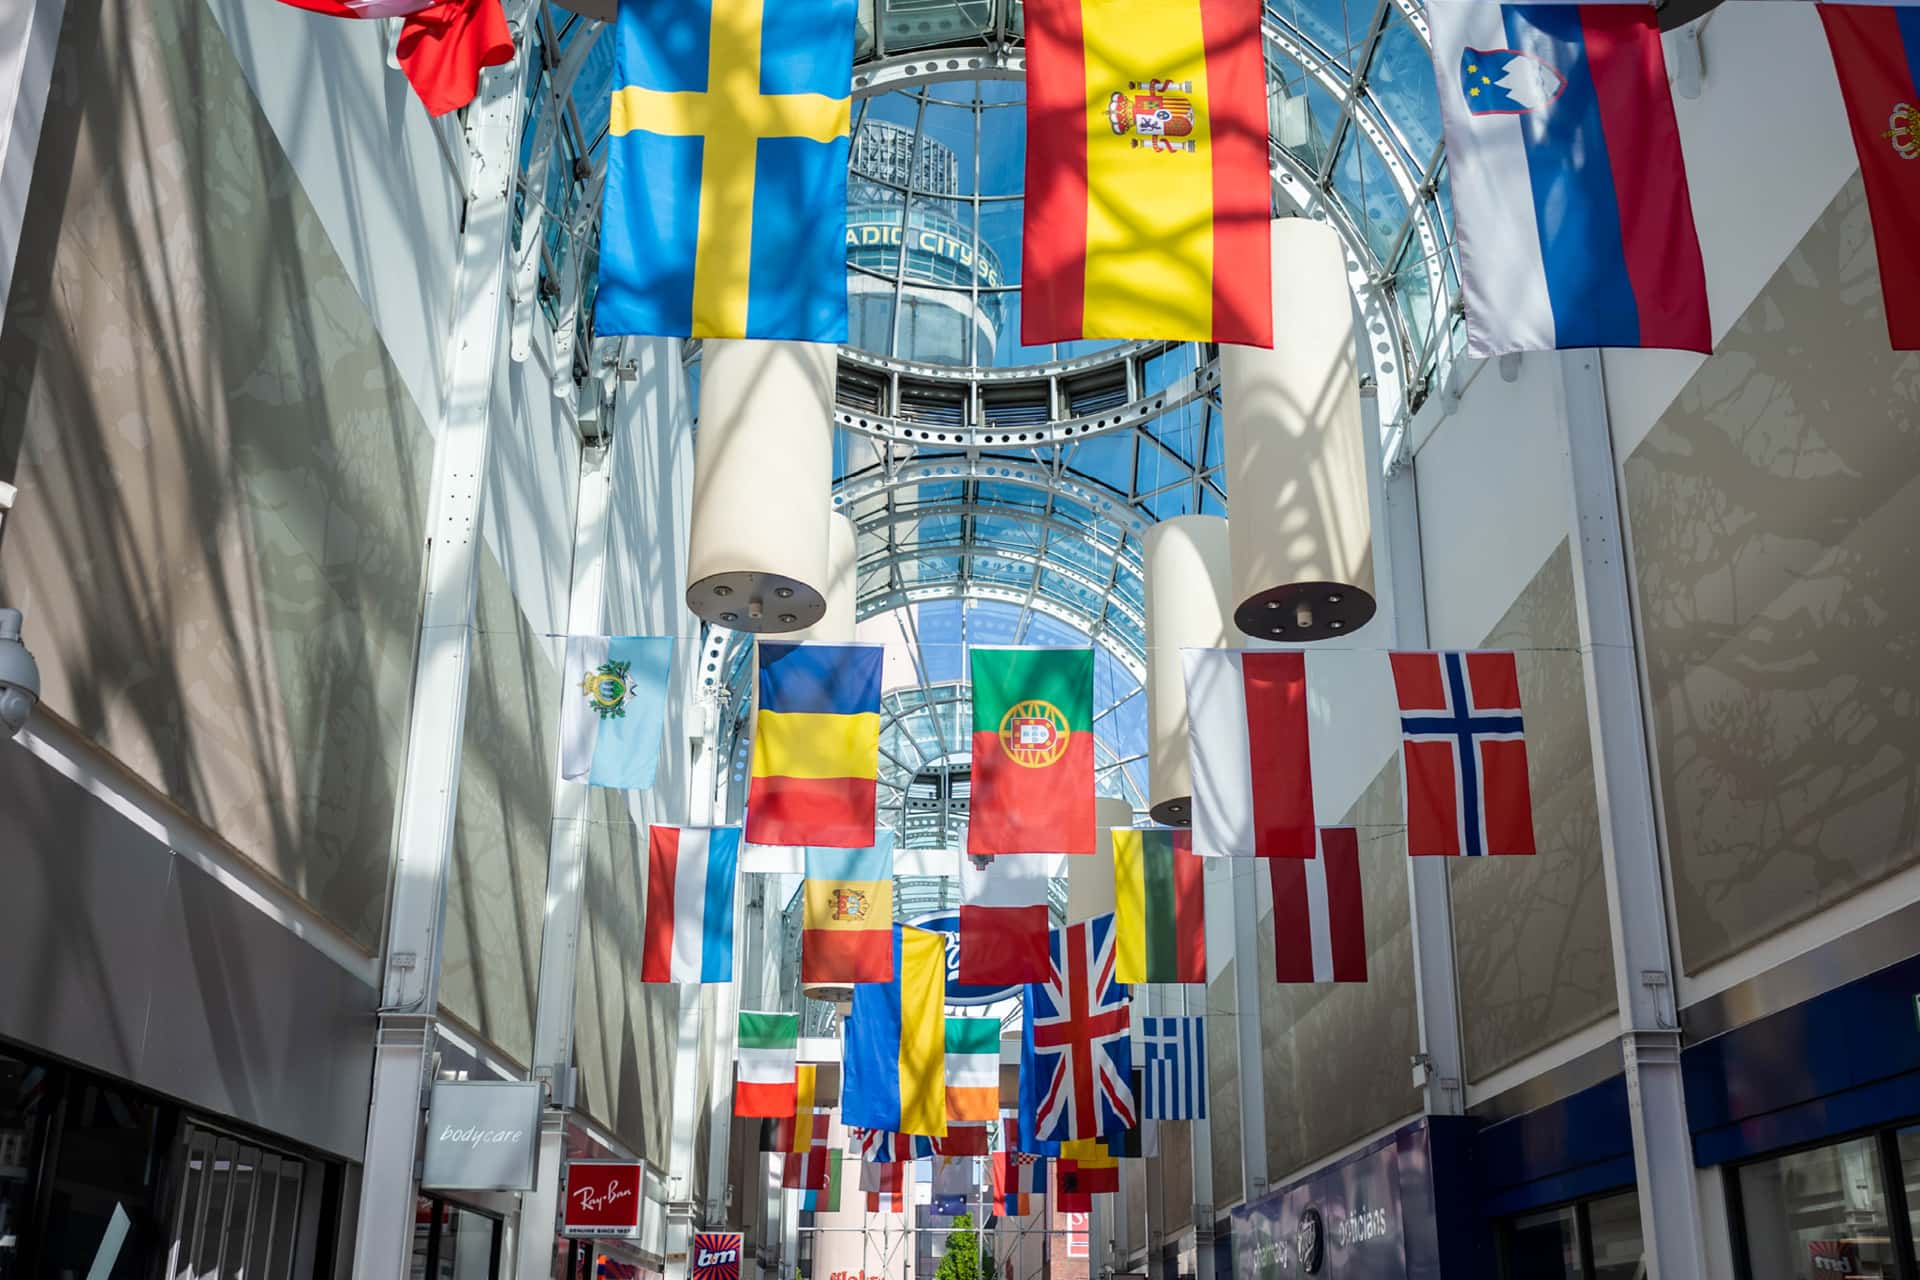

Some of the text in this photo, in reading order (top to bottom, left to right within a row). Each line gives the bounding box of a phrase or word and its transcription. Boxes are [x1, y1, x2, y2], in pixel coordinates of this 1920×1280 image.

[846, 226, 903, 245] ADIO
[920, 232, 973, 266] CITY
[439, 1124, 523, 1149] bodycare
[1338, 1204, 1386, 1249] opticians
